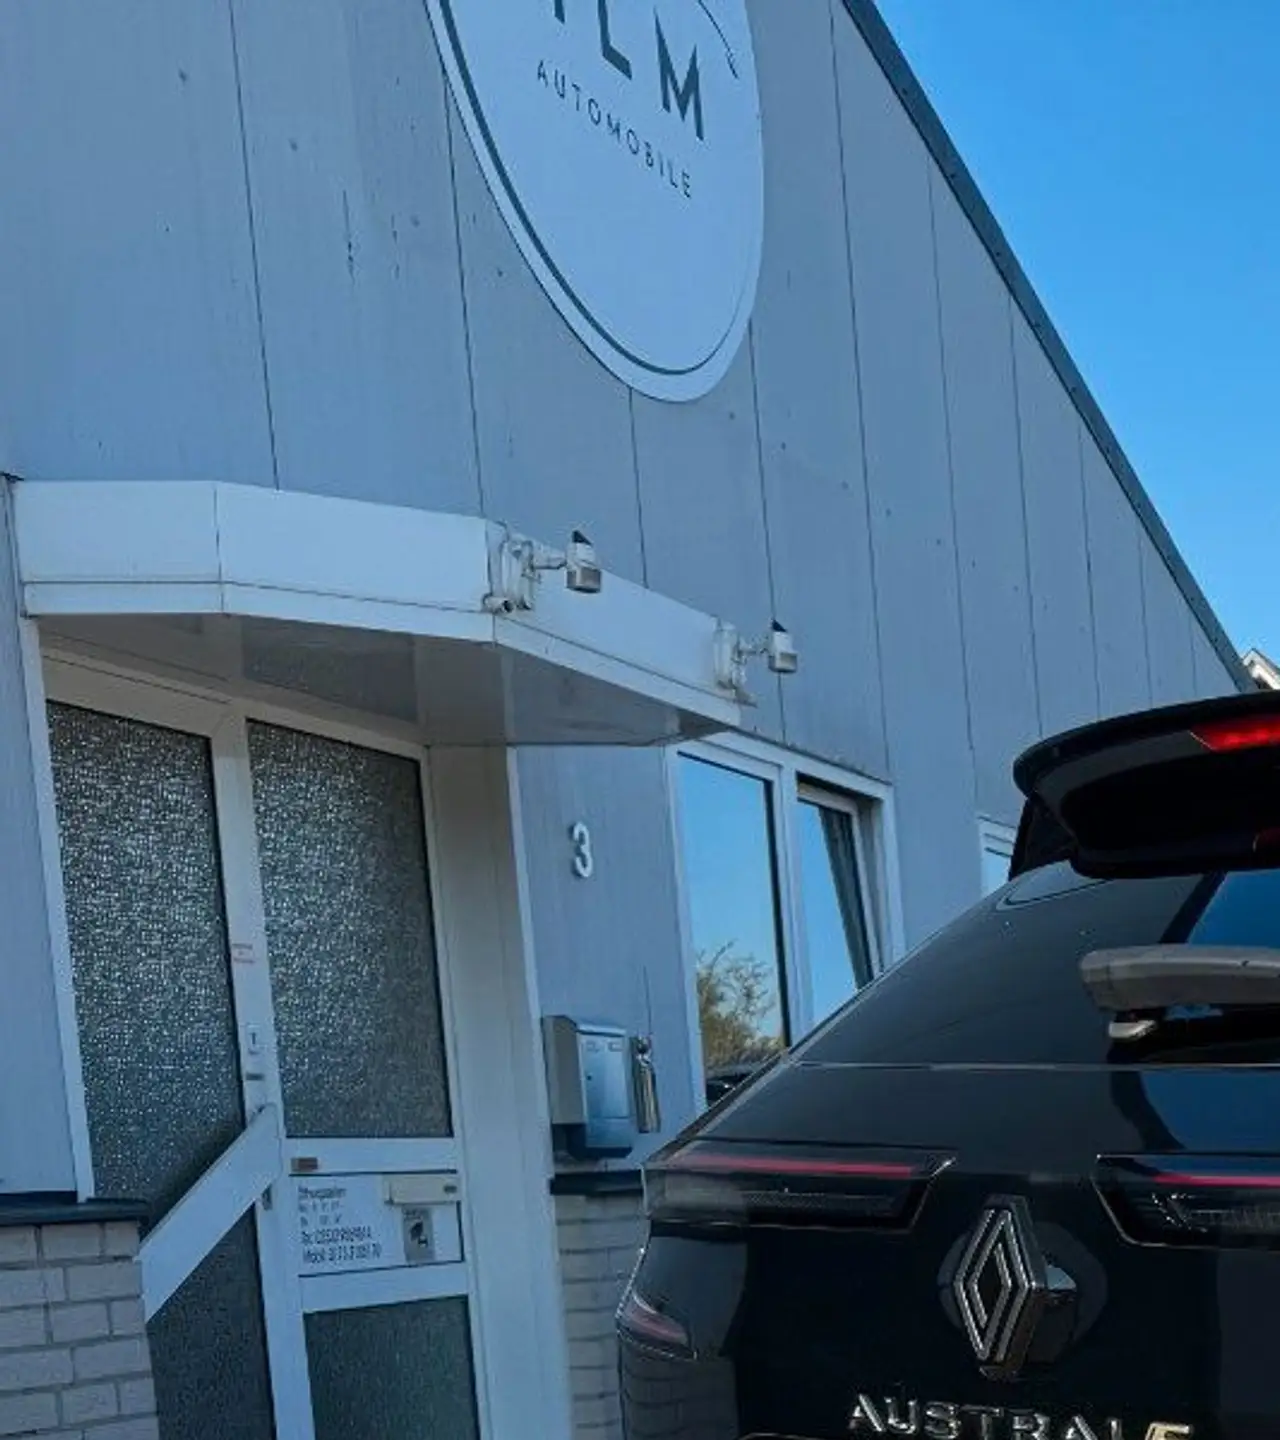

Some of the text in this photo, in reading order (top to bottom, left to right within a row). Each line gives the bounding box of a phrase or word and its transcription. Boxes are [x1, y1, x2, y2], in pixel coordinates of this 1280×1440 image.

[538, 60, 691, 198] AUTOMOBILE
[554, 0, 704, 141] LM
[571, 822, 593, 878] 3
